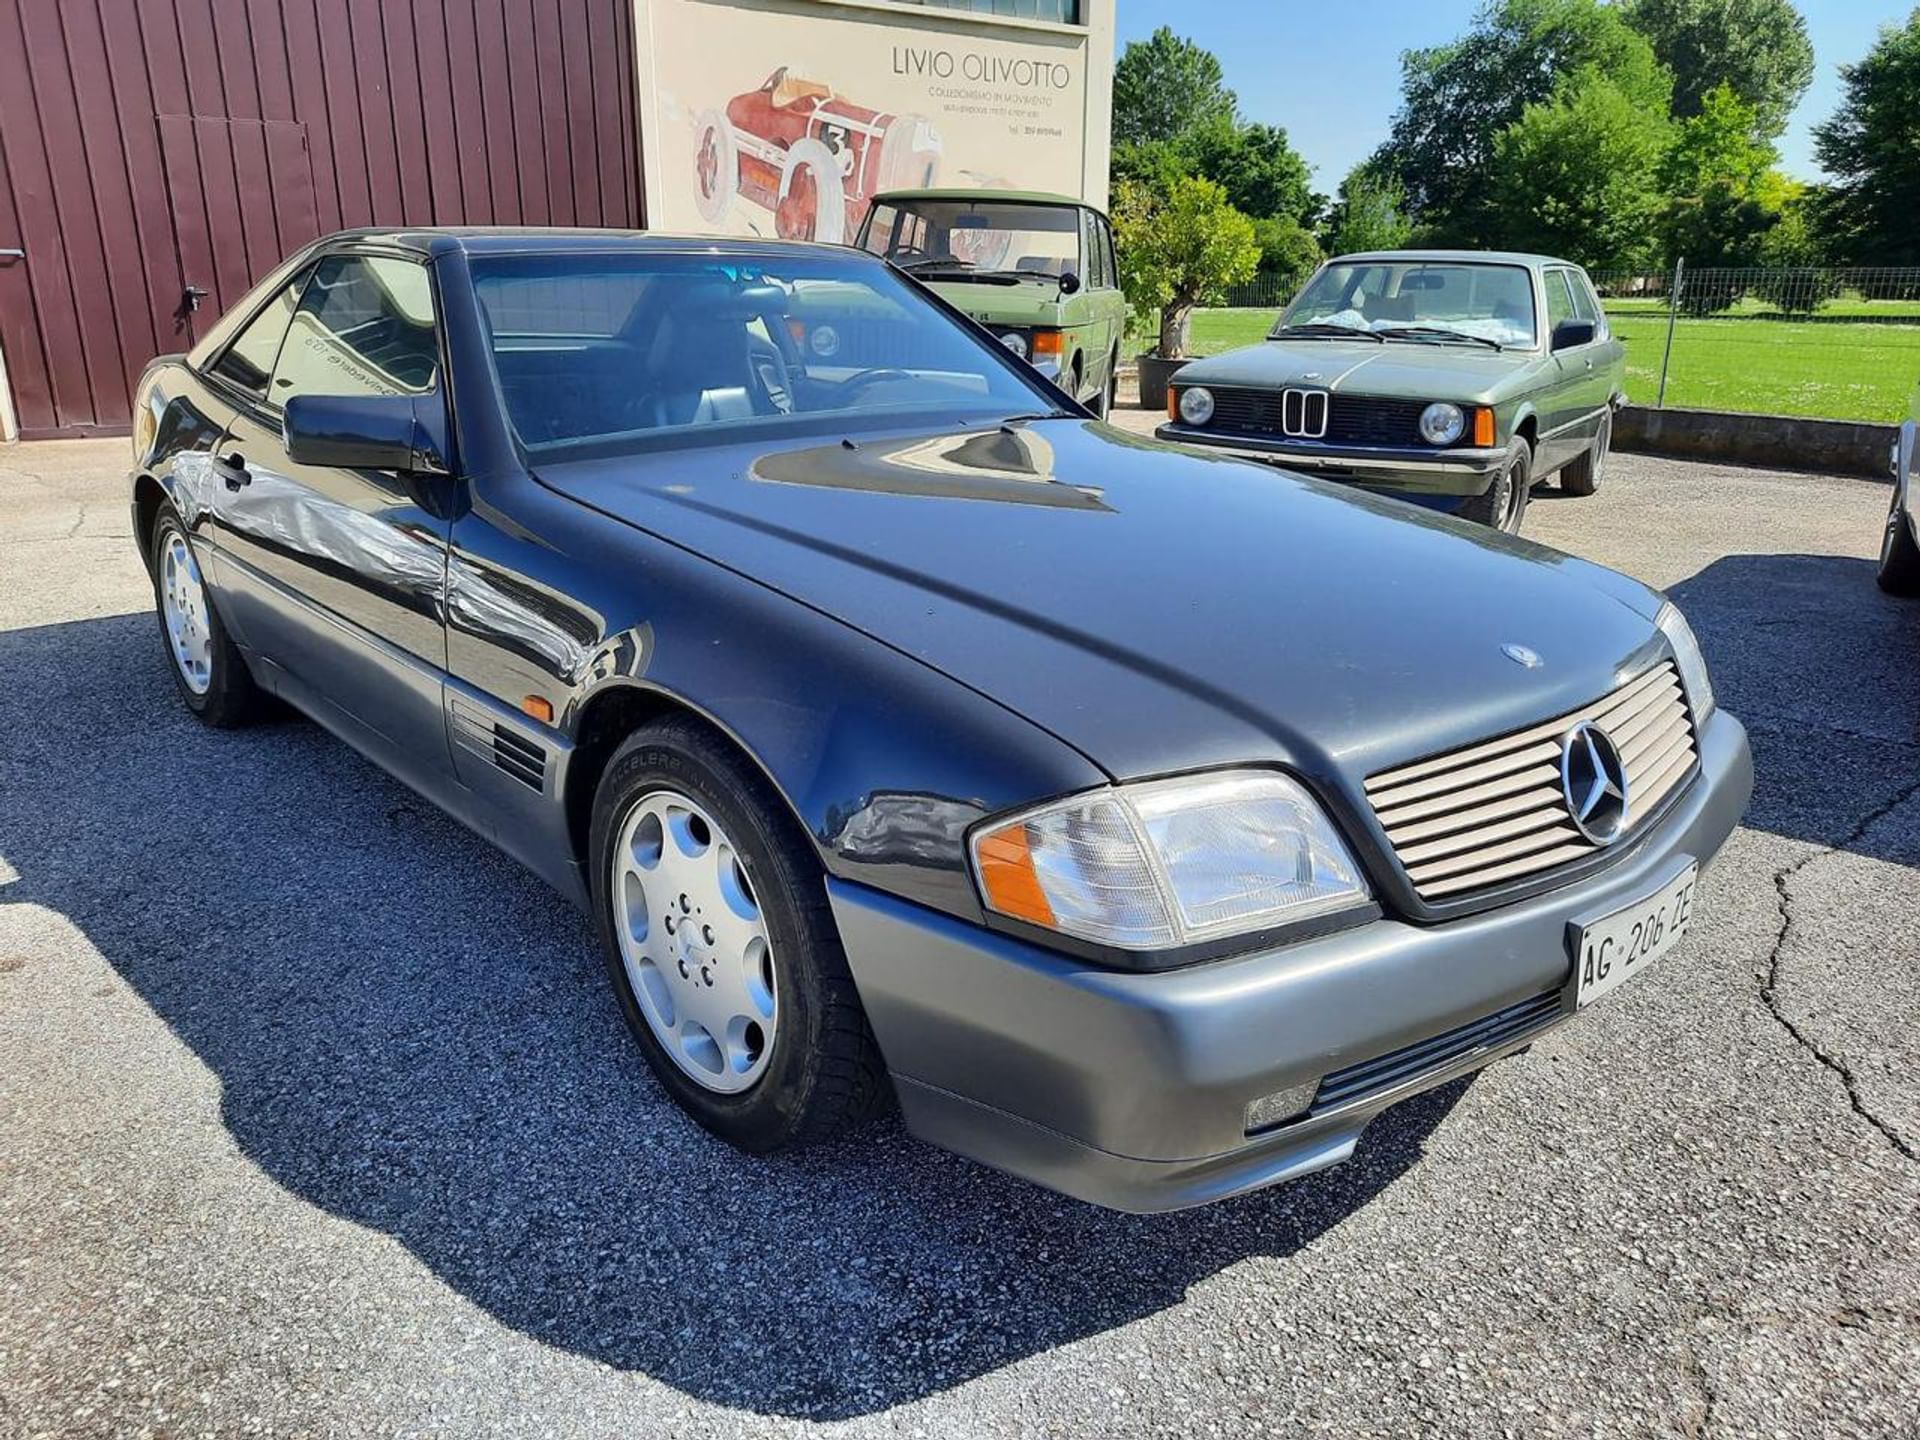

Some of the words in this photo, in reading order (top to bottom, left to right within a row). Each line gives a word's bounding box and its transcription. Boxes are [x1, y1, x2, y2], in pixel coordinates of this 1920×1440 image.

[892, 46, 954, 78] LIVIO
[962, 53, 1070, 90] OLIVOTTO
[1581, 936, 1614, 993] AG
[1625, 906, 1665, 966] 206
[1670, 882, 1693, 933] ZE
